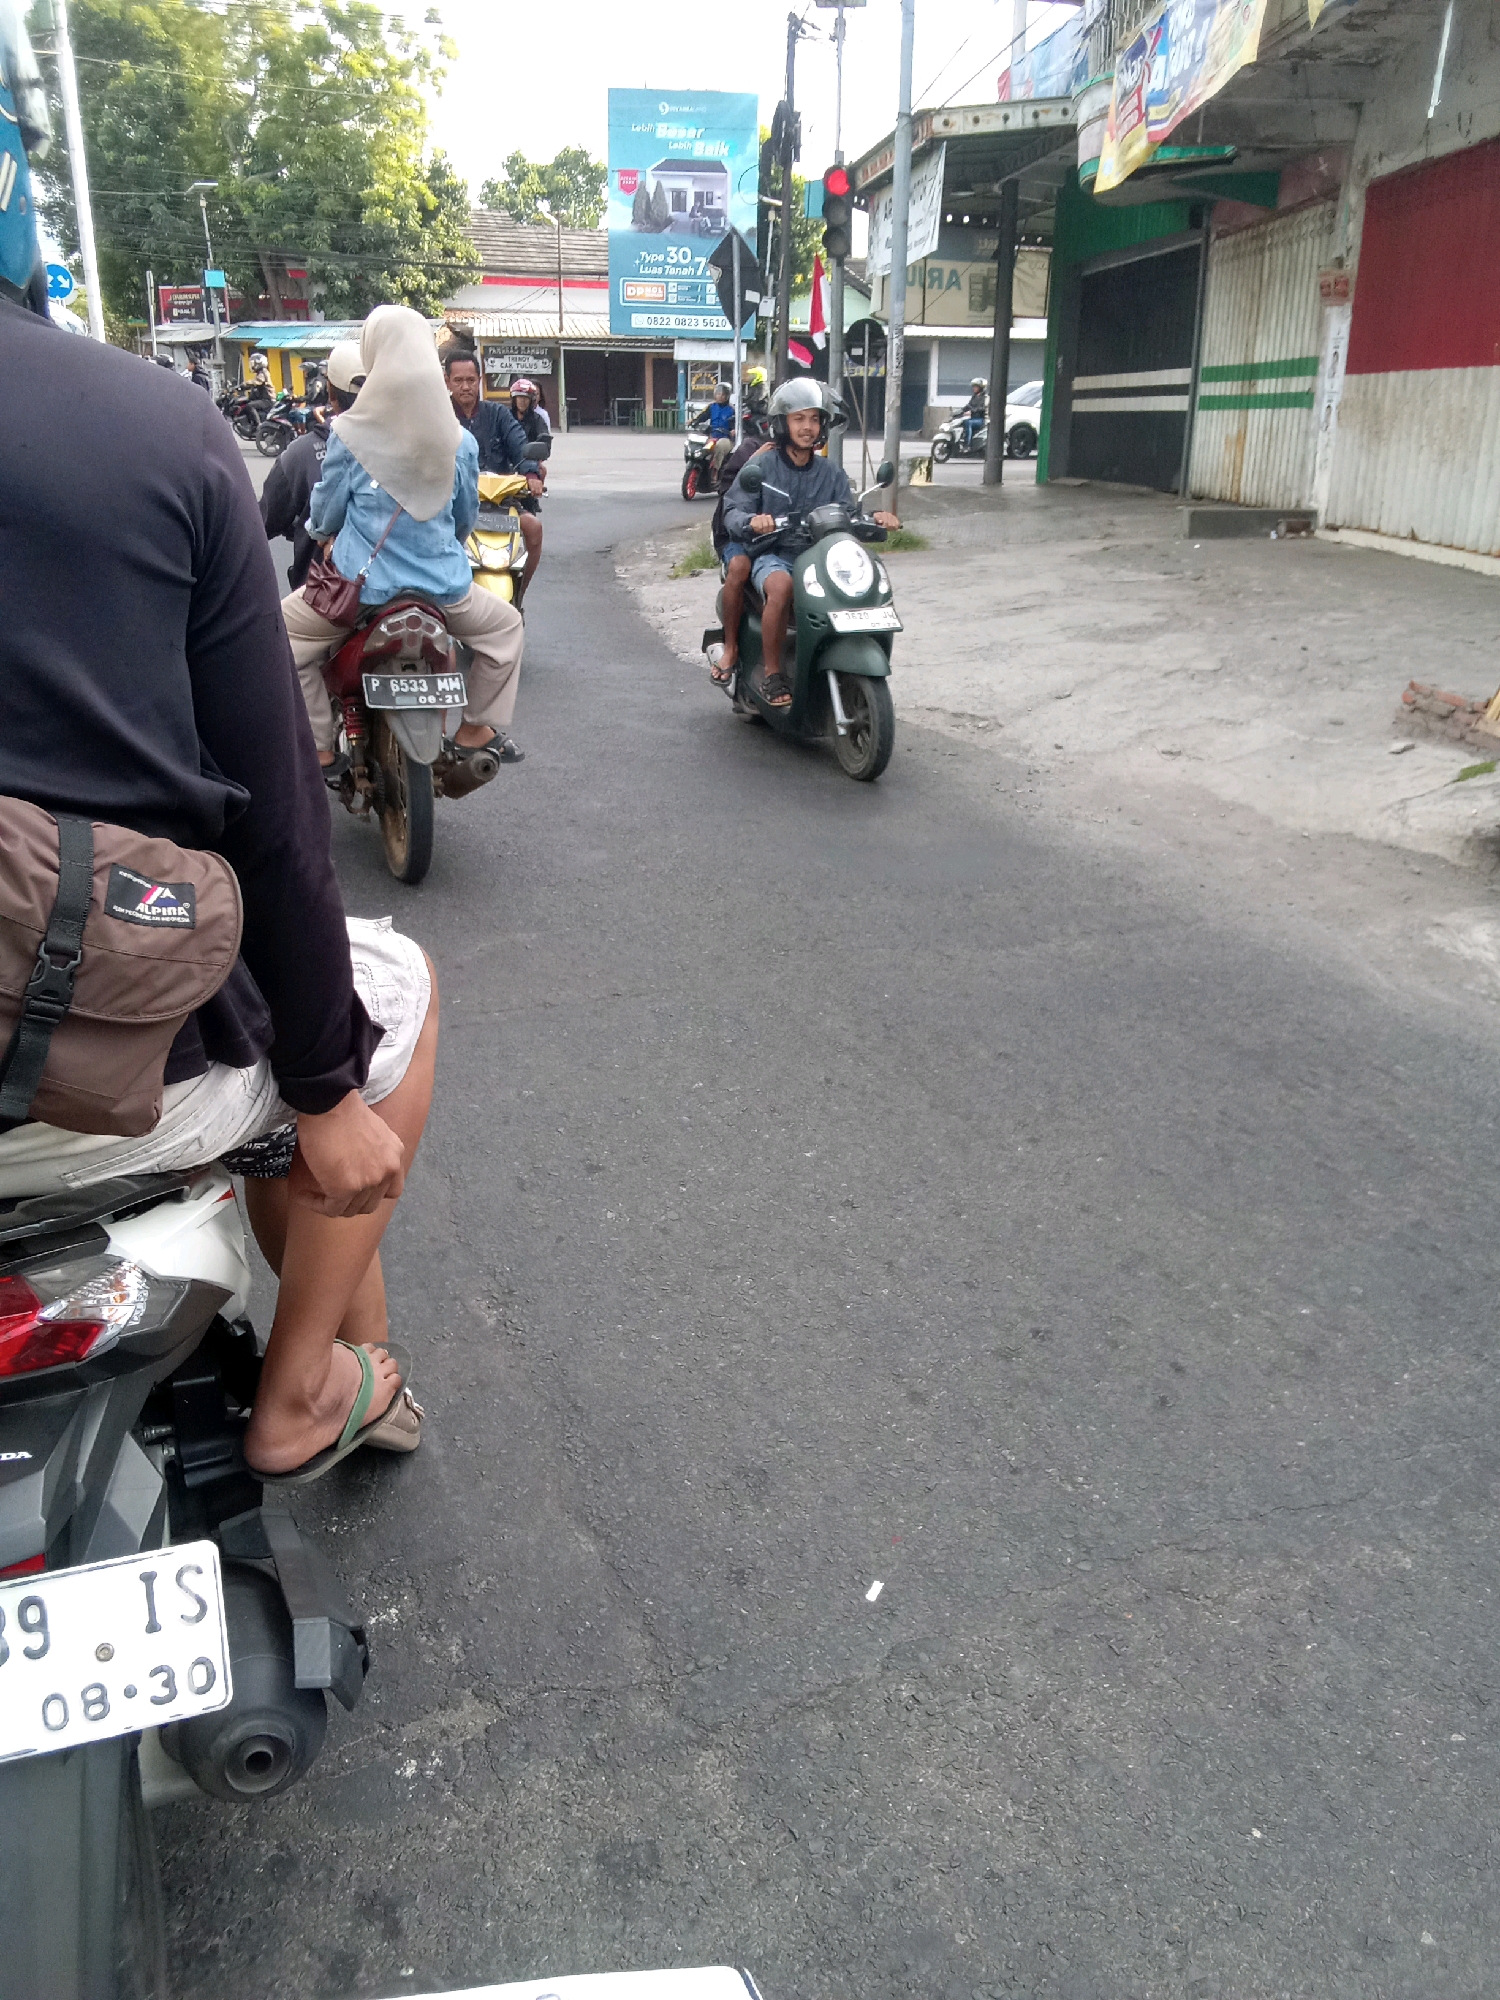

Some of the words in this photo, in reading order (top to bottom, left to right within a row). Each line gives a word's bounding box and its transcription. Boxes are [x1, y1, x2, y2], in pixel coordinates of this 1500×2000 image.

[693, 140, 730, 156] Baik
[640, 251, 665, 262] Type
[666, 246, 692, 264] 30
[640, 265, 663, 274] Luas
[664, 265, 695, 276] Tanah
[695, 257, 711, 276] 7
[626, 286, 645, 297] DP
[646, 317, 671, 326] 0822
[674, 317, 699, 327] 0823
[702, 318, 727, 328] 5610
[371, 678, 380, 691] P
[390, 679, 428, 693] 6533
[135, 903, 189, 916] ALPINA
[140, 1564, 208, 1633] IS
